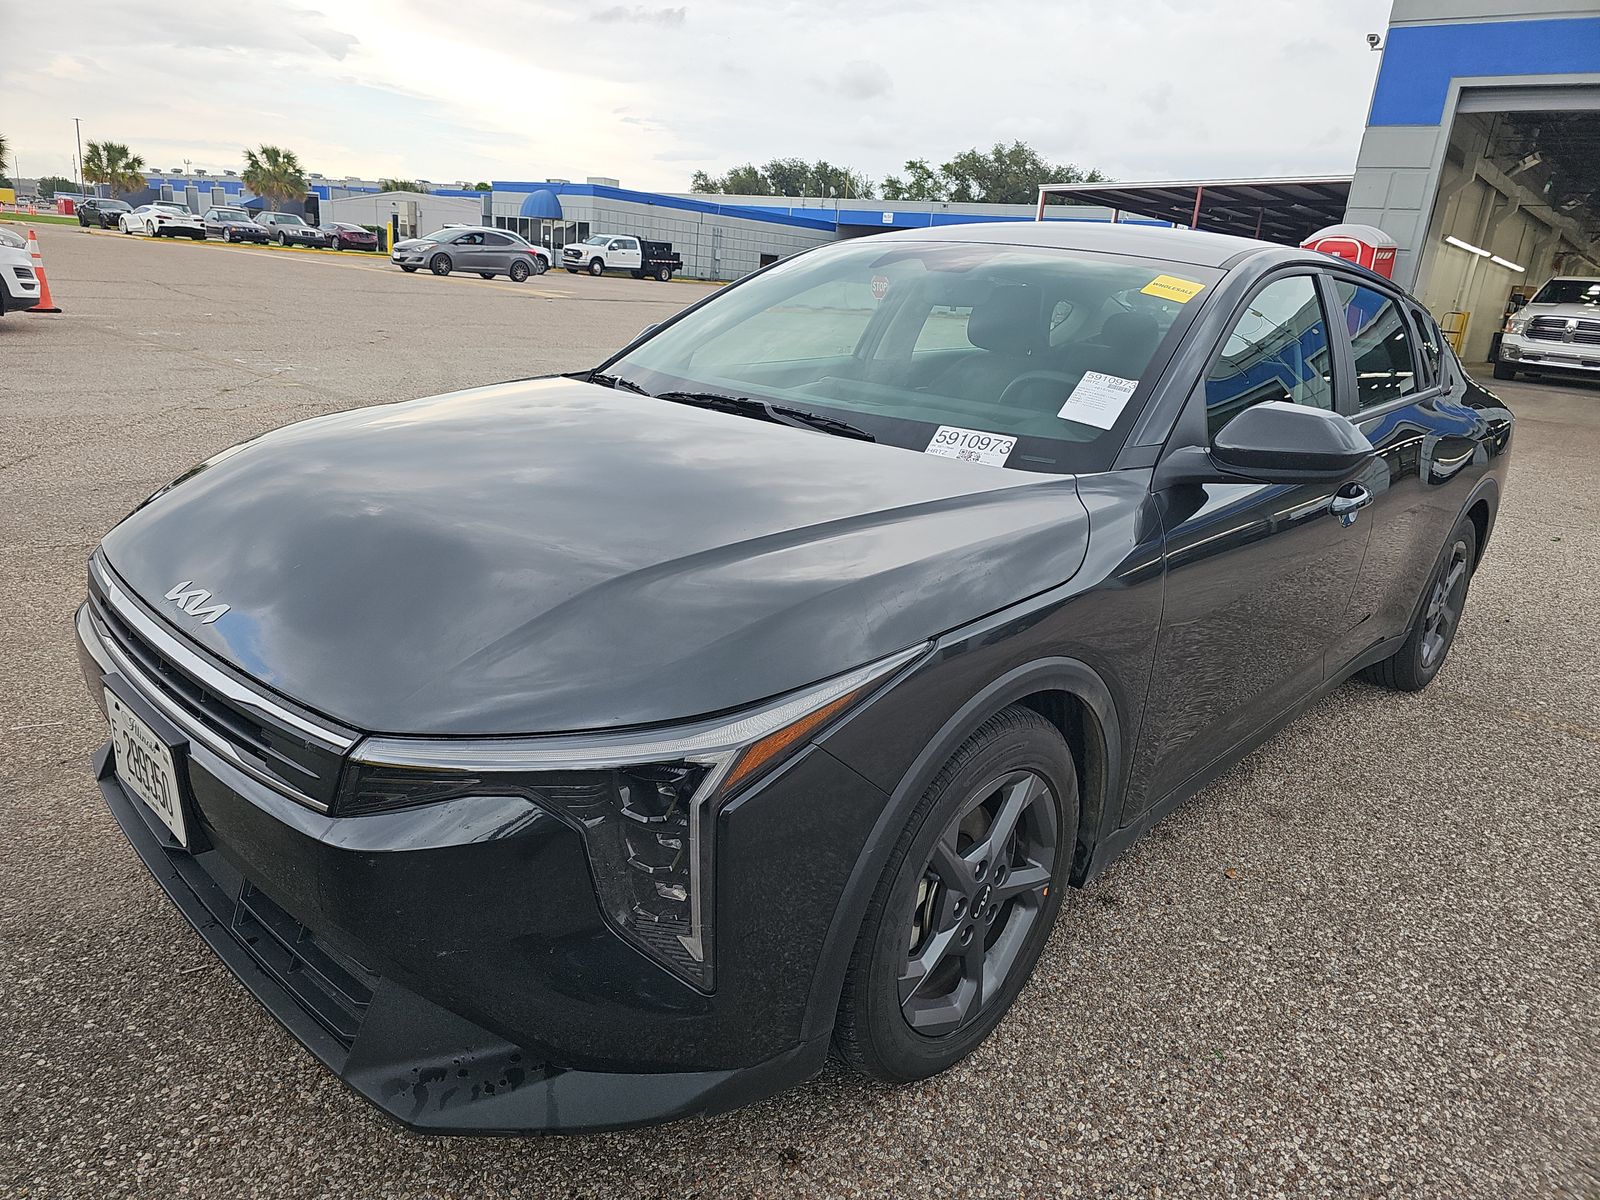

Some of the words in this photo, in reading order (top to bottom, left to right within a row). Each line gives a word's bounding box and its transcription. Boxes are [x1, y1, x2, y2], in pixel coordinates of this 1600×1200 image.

[872, 281, 887, 292] STOP
[1152, 281, 1193, 295] WHOLESALE
[1087, 372, 1137, 389] 5910973
[935, 430, 1013, 455] 5910973
[164, 580, 231, 624] KIA
[122, 729, 174, 817] 289350
